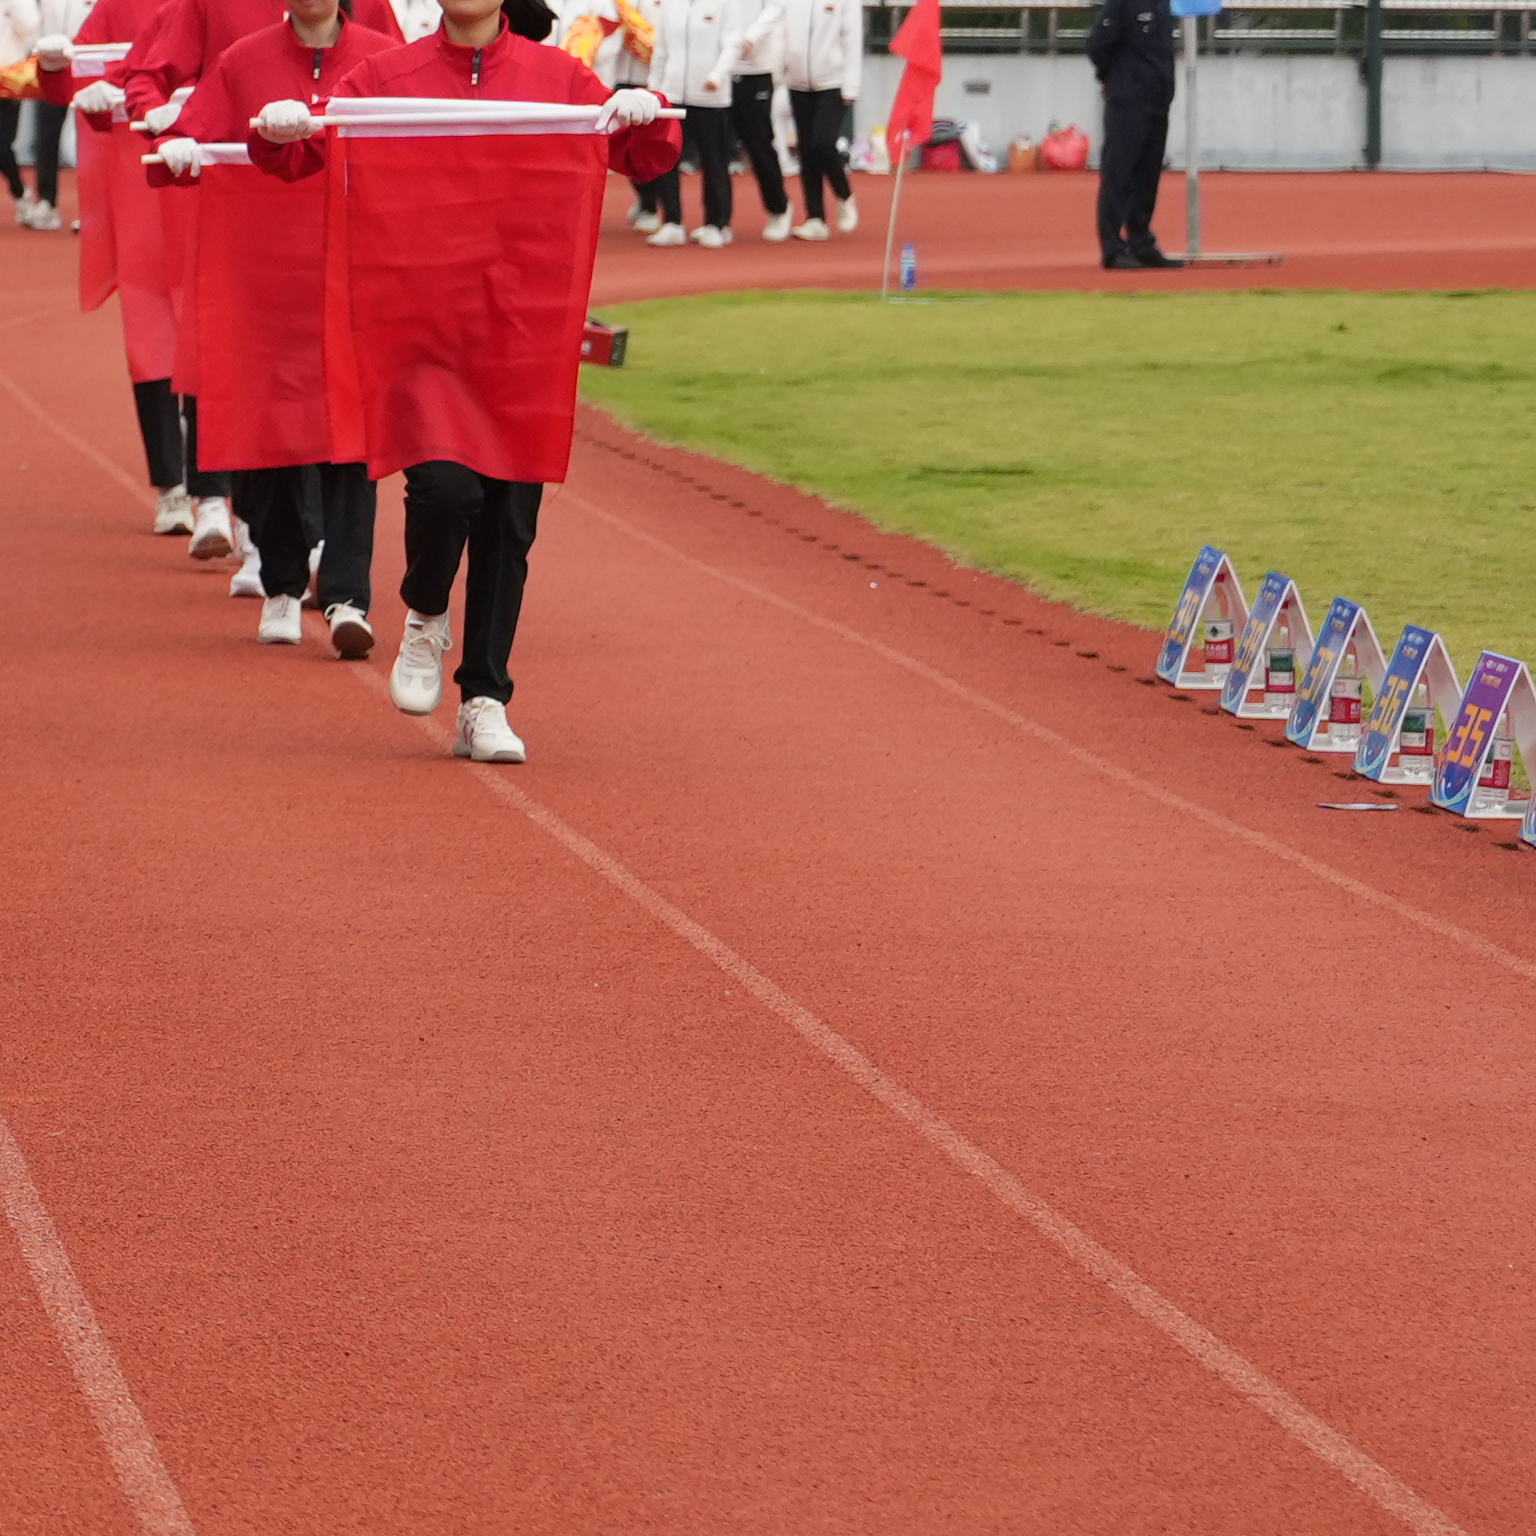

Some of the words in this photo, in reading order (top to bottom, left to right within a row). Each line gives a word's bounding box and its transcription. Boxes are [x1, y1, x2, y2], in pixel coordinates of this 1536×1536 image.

[1301, 645, 1335, 705] 37
[1370, 675, 1409, 734] 36
[1447, 703, 1493, 768] 35
